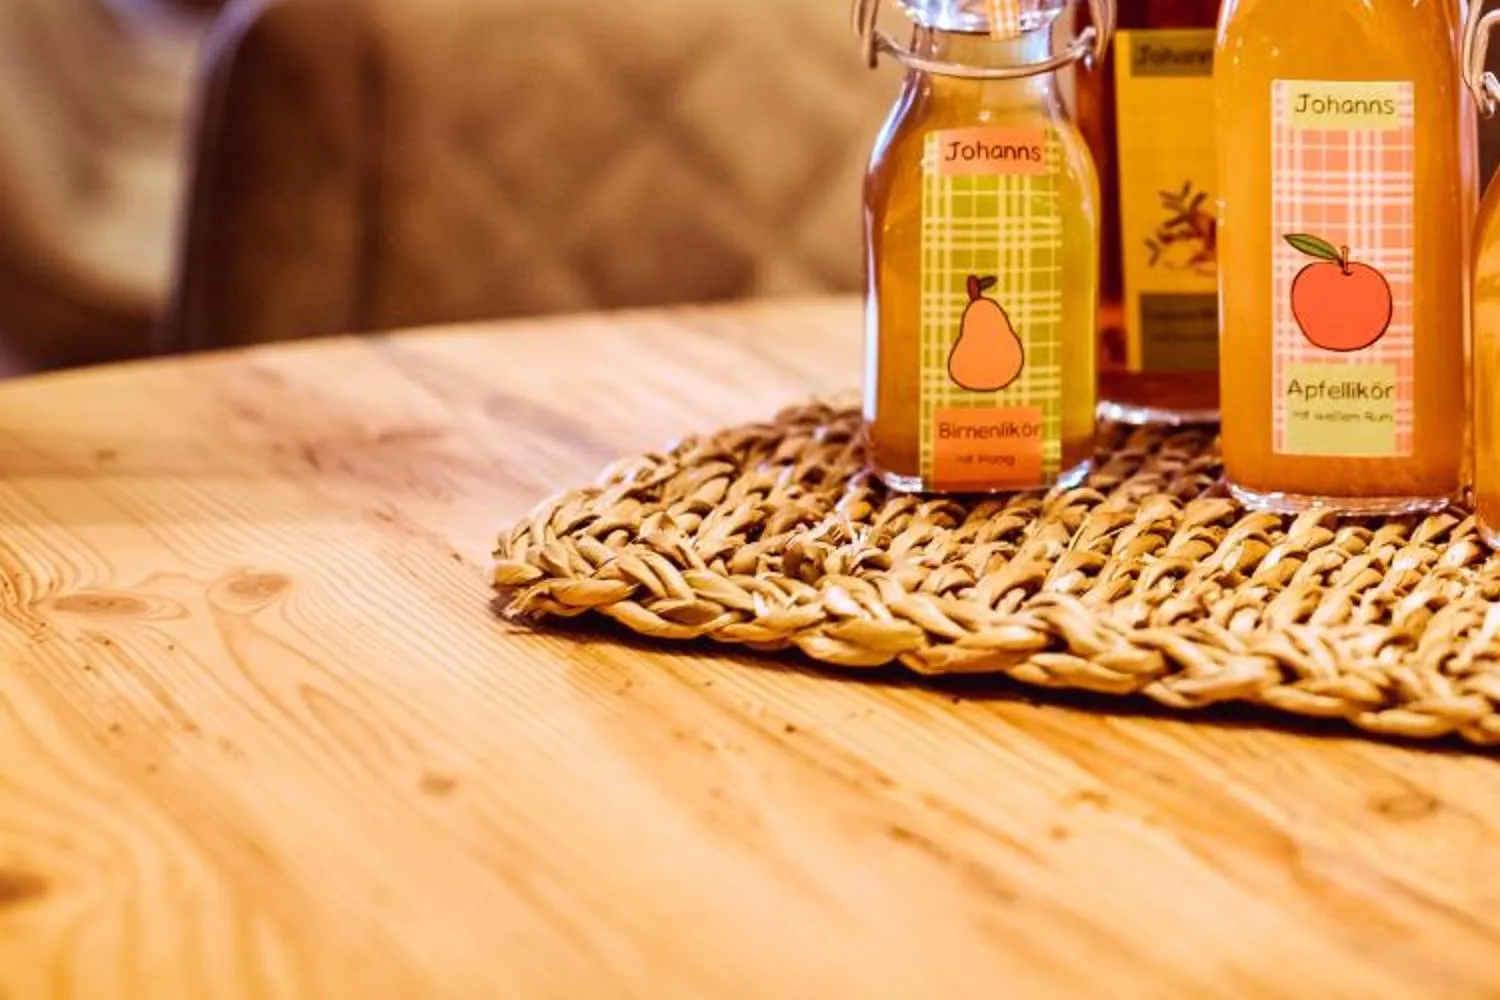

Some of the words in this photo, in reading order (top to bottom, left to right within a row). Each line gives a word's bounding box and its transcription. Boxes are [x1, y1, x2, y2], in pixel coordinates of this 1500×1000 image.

[1135, 44, 1214, 67] Johann
[1294, 92, 1396, 116] Johanns
[944, 140, 1043, 162] Johanns
[1286, 377, 1395, 402] Apfellikör
[938, 420, 1041, 440] Birnenlikör
